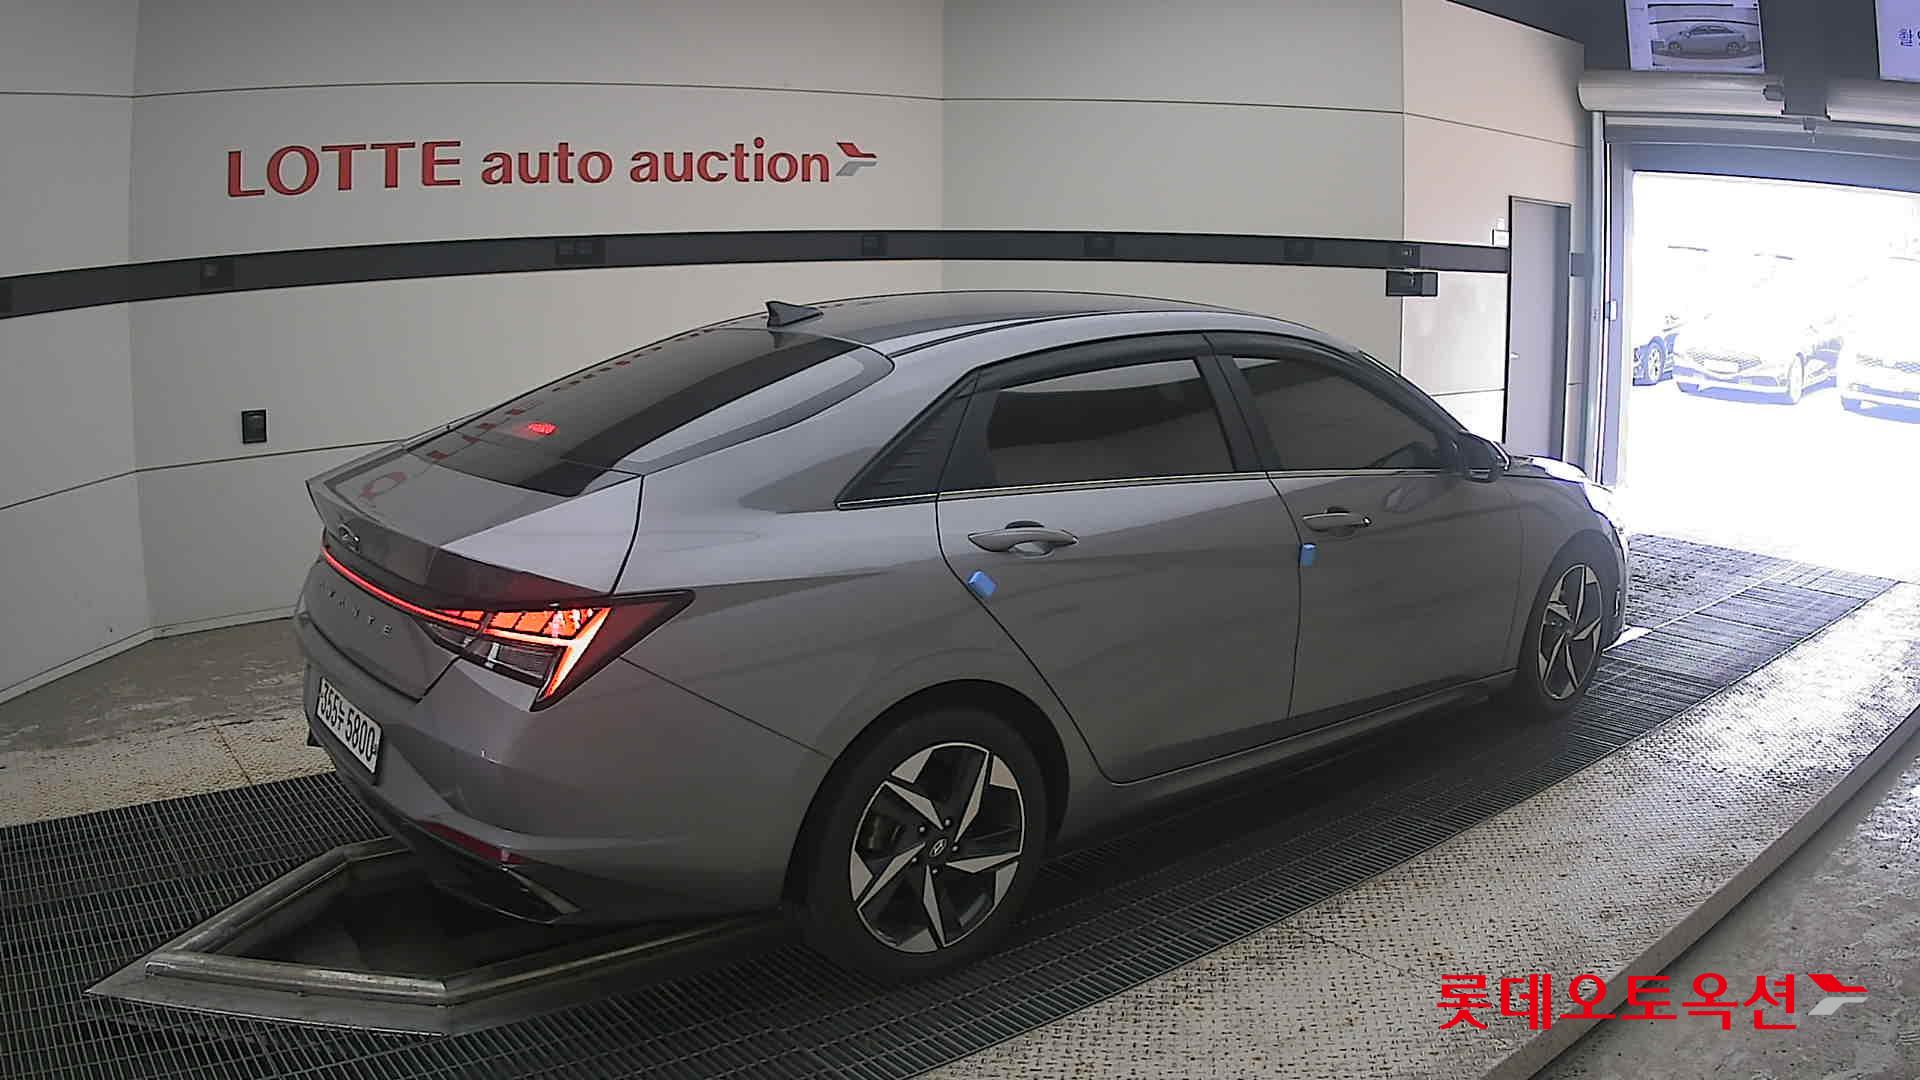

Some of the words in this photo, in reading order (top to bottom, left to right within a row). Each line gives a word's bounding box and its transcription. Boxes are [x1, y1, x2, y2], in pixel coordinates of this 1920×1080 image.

[228, 141, 461, 197] LOTTE
[480, 143, 612, 185] auto
[629, 137, 830, 183] auction
